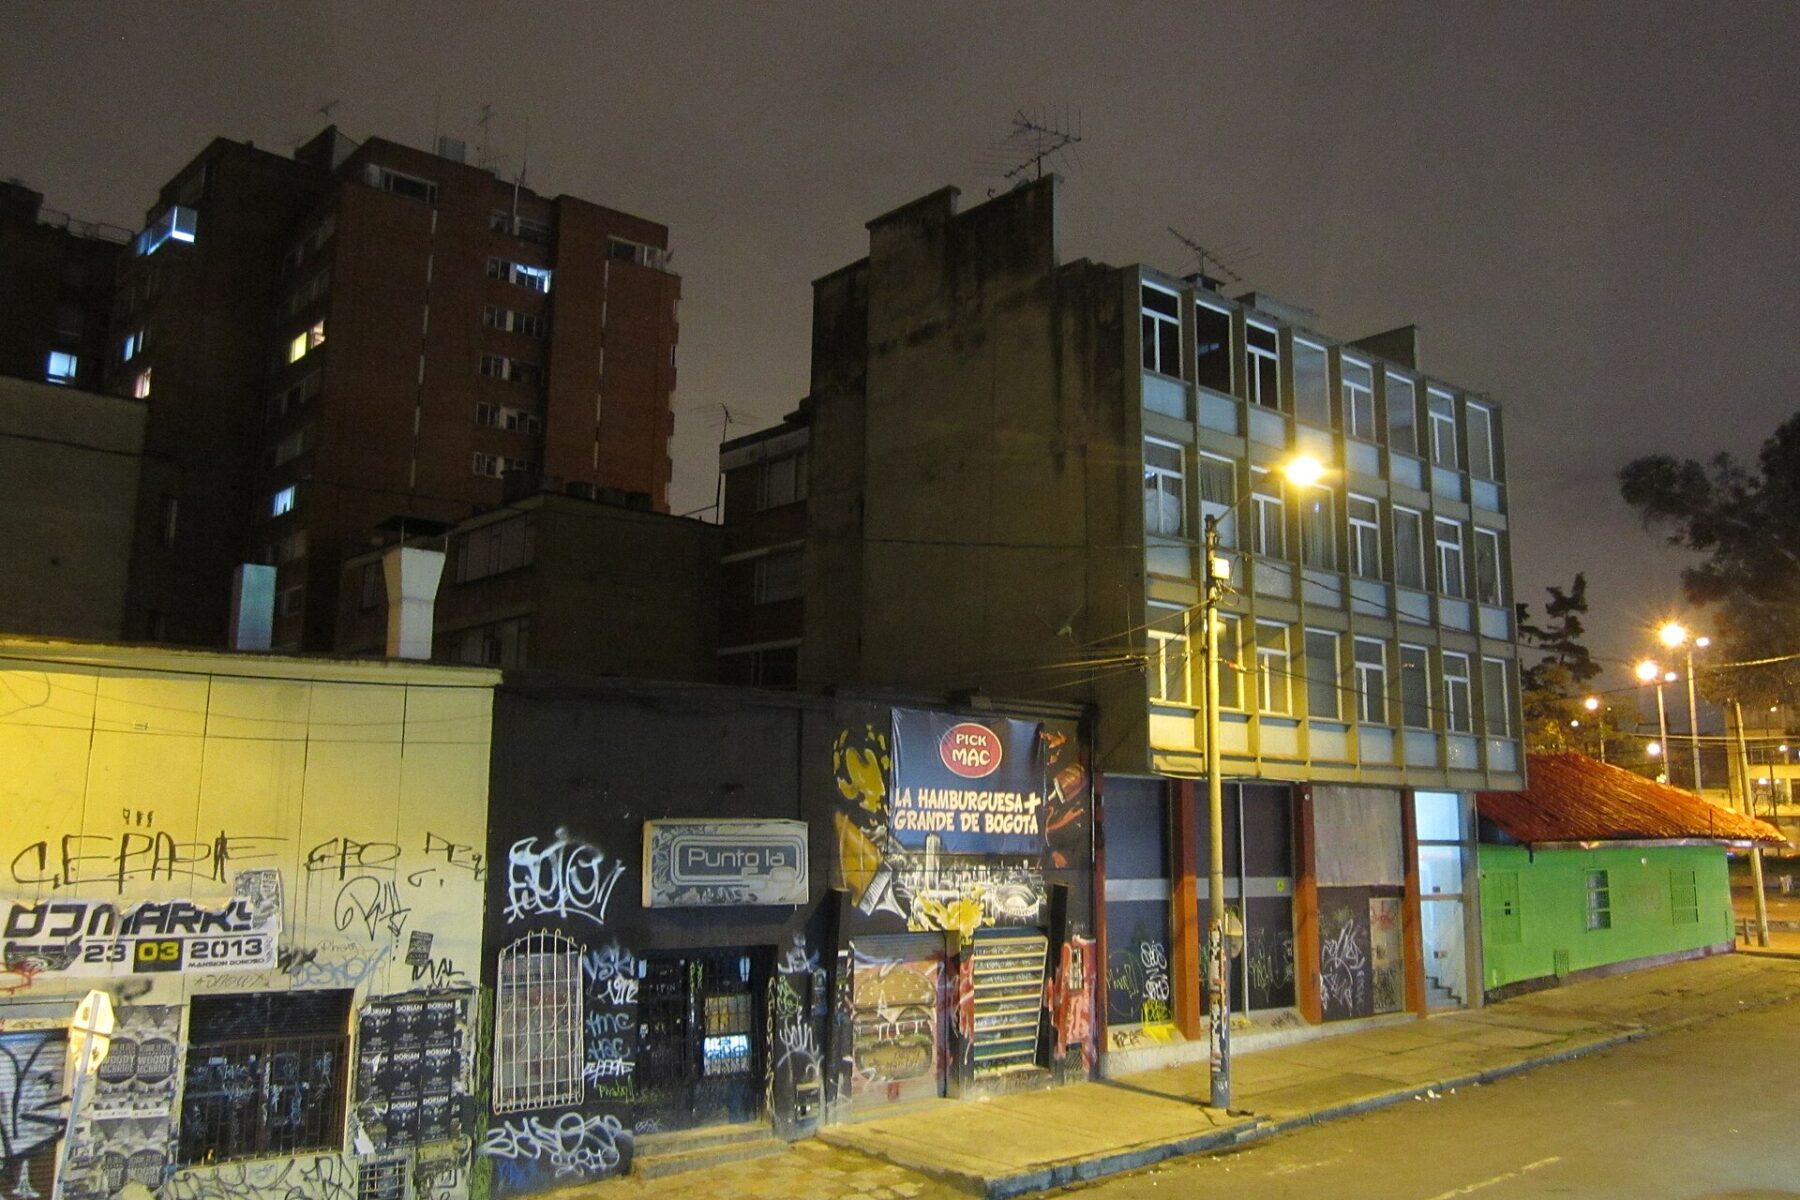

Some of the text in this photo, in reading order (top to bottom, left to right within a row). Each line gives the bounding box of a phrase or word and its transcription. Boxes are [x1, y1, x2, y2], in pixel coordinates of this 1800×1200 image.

[955, 733, 987, 746] PICK
[952, 748, 991, 767] MAC
[895, 787, 912, 807] LA
[918, 788, 1023, 813] HAMBURGUESA
[894, 809, 1039, 834] GRANDE DE BOGOTA
[688, 848, 785, 867] Punto la
[84, 938, 263, 963] 23 03 2013
[396, 1004, 423, 1013] DORIAN
[427, 1002, 453, 1010] DORIAN
[393, 1053, 420, 1061] DORIAN
[425, 1048, 452, 1056] DORIAN
[391, 1102, 418, 1110] DORIAN
[422, 1096, 449, 1105] DORIAN
